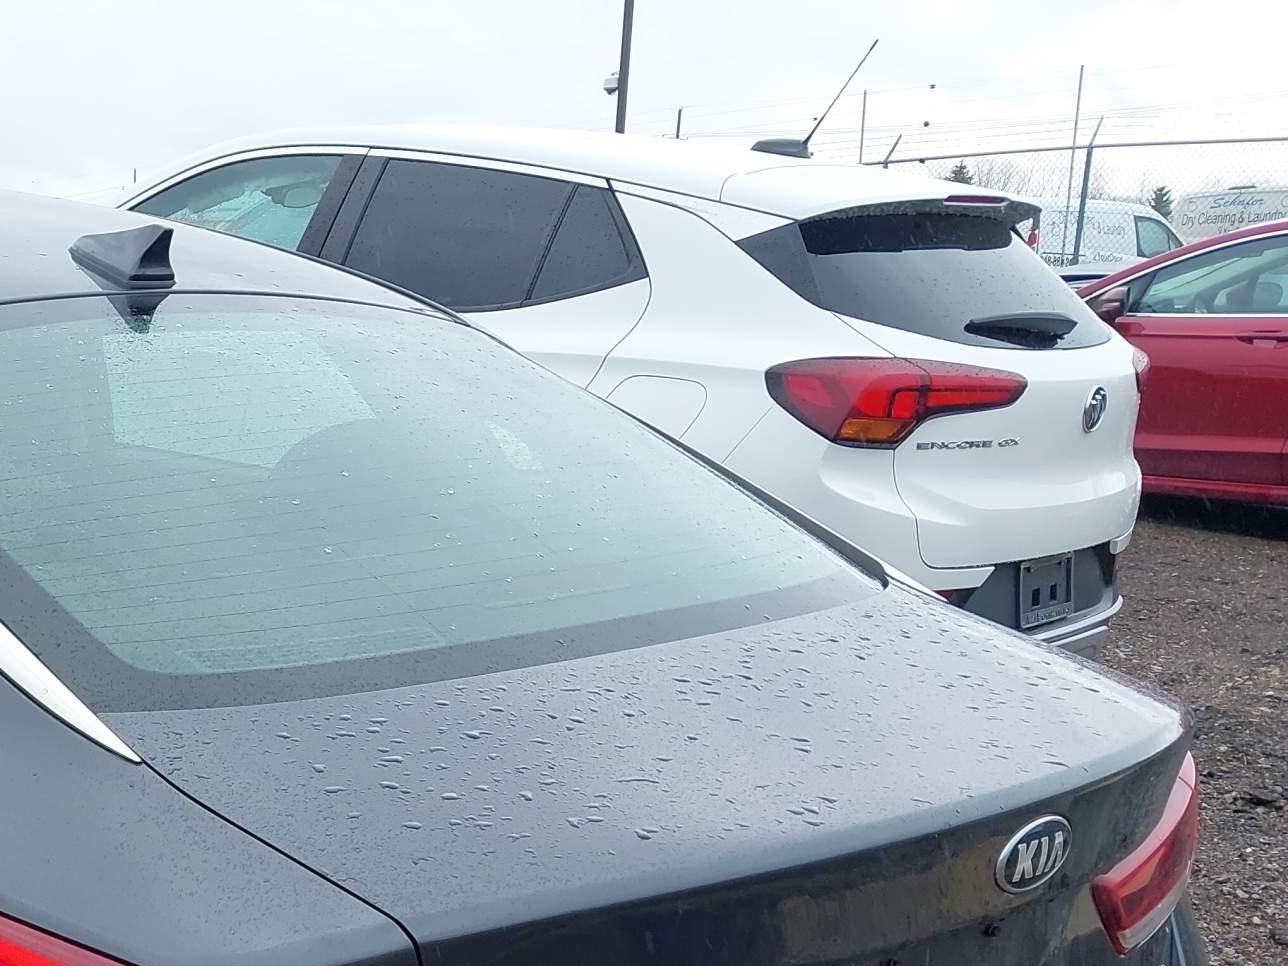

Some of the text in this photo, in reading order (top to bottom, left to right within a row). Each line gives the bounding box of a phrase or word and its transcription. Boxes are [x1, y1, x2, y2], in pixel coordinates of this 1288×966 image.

[1181, 213, 1196, 228] Dry
[1198, 211, 1236, 226] Cleaning
[1238, 210, 1244, 223] &
[916, 440, 993, 450] ENCORE
[1012, 830, 1064, 882] KIA
